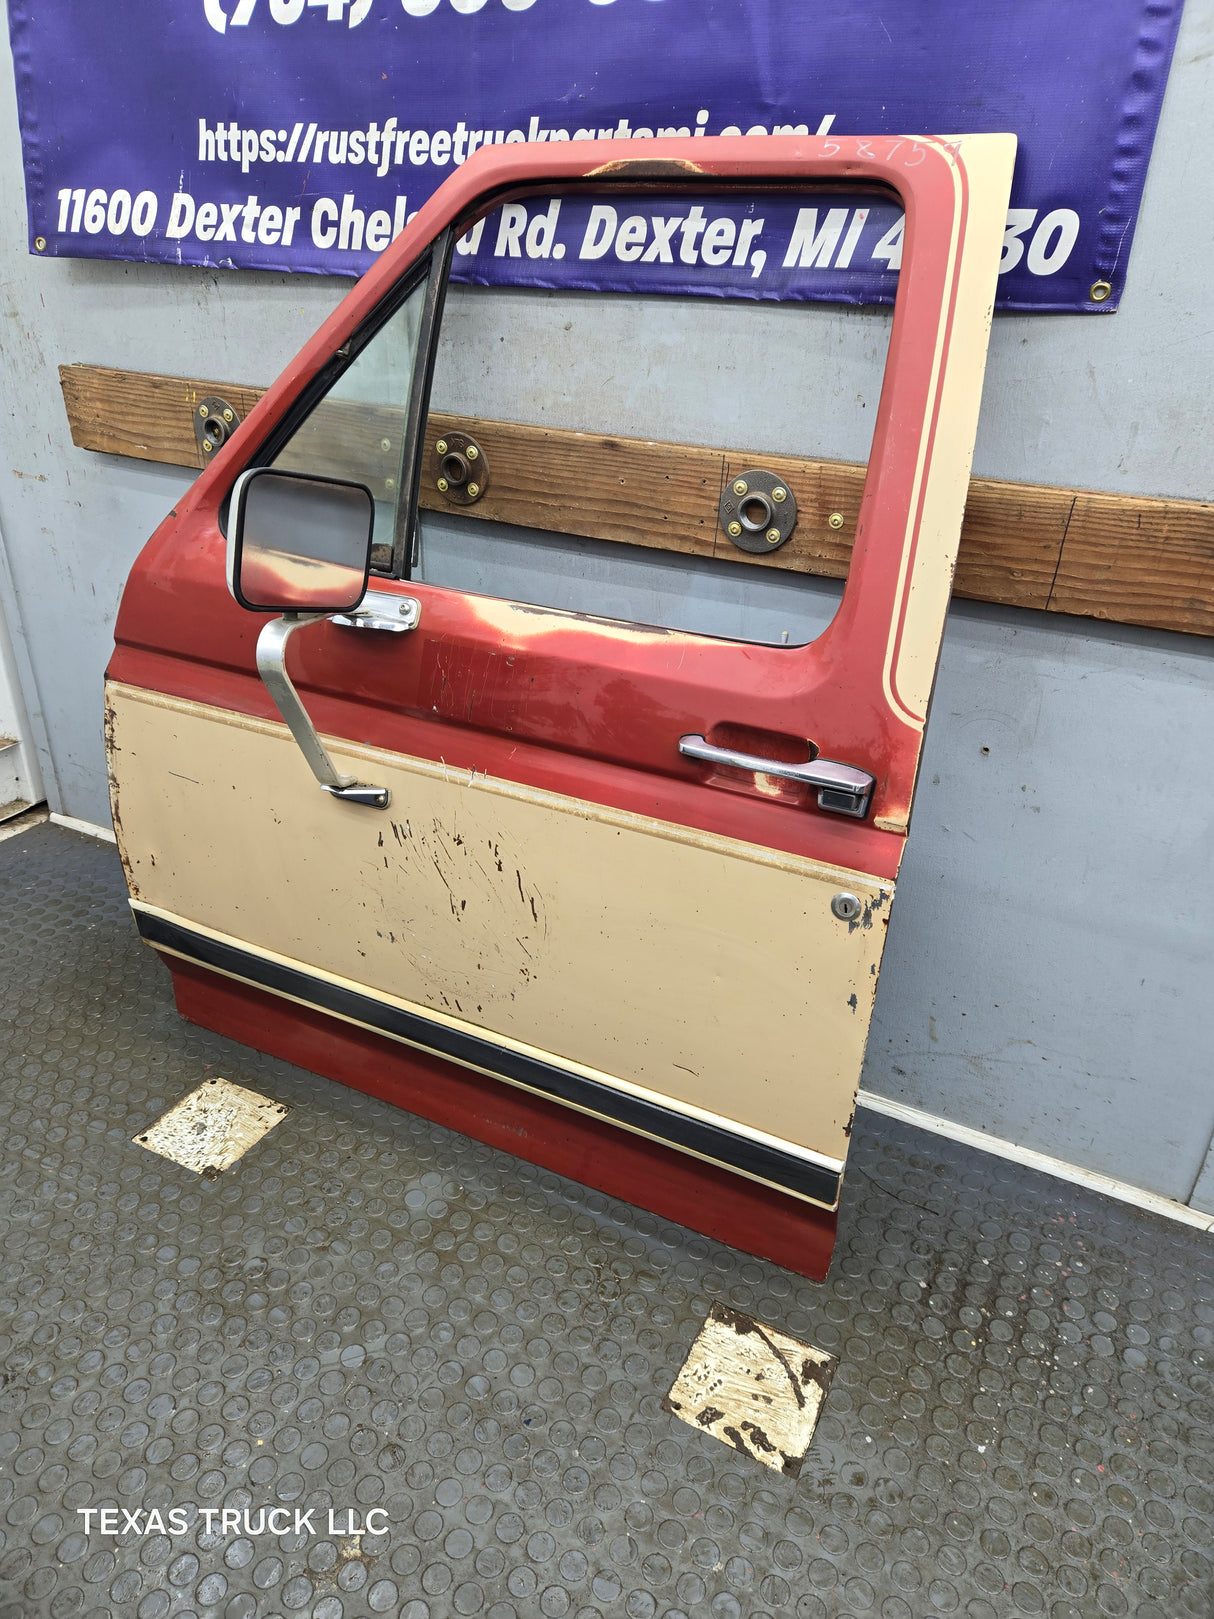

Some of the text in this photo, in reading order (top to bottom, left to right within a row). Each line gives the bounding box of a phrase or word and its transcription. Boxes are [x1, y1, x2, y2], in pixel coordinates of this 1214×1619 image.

[57, 188, 1080, 278] 11600 Dexter Chela Rd. Dexter, MI 430
